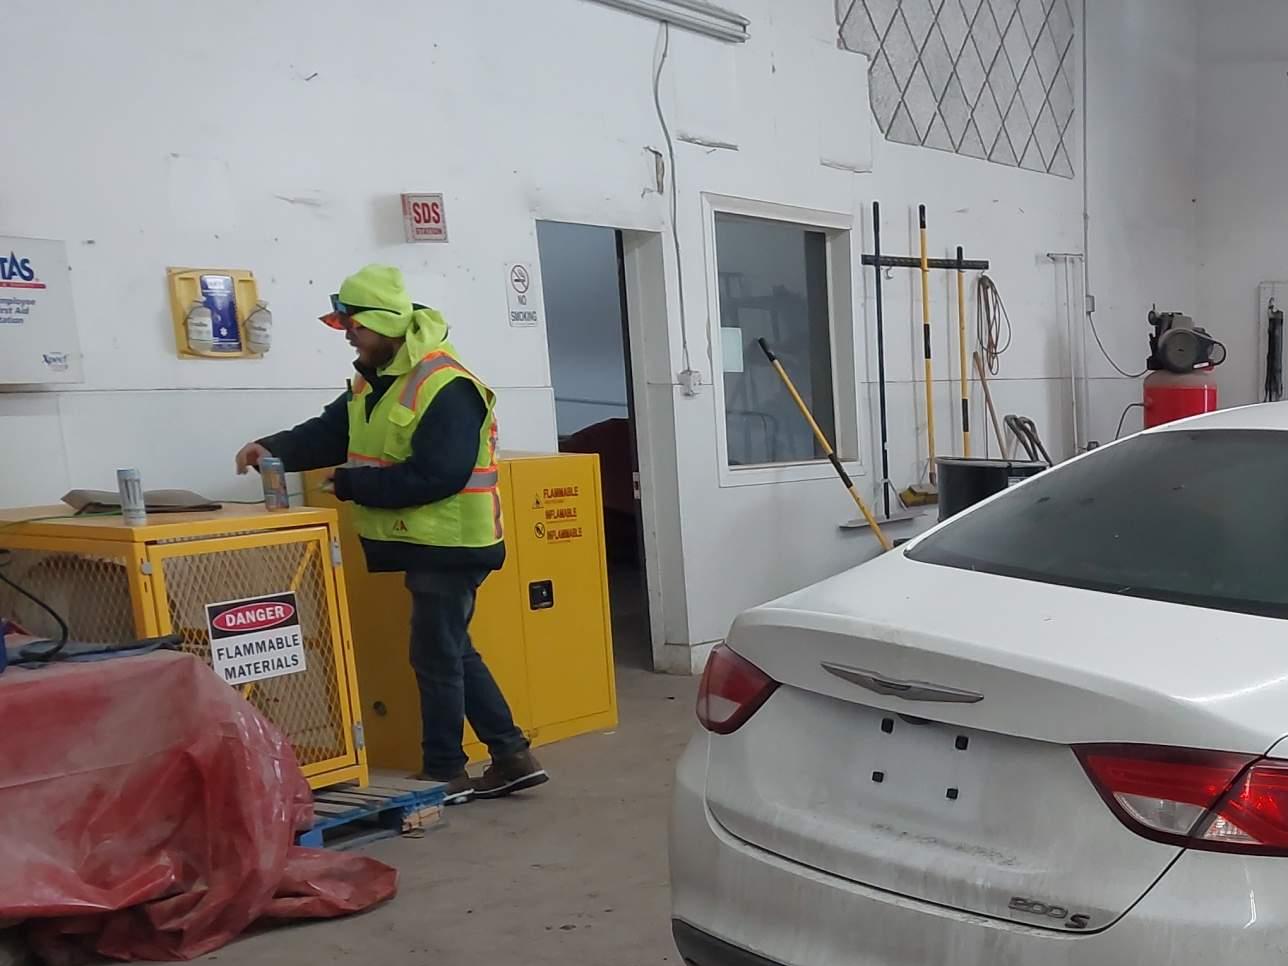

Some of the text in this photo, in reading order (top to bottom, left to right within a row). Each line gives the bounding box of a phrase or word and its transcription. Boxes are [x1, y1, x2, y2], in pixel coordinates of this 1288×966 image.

[412, 202, 441, 224] SDS
[517, 294, 527, 306] NO
[511, 311, 538, 321] SMOKING
[543, 486, 579, 498] FLAMMABLE
[225, 605, 285, 626] DANGER
[216, 633, 300, 661] FLAMMABLE
[224, 654, 299, 681] MATERIALS
